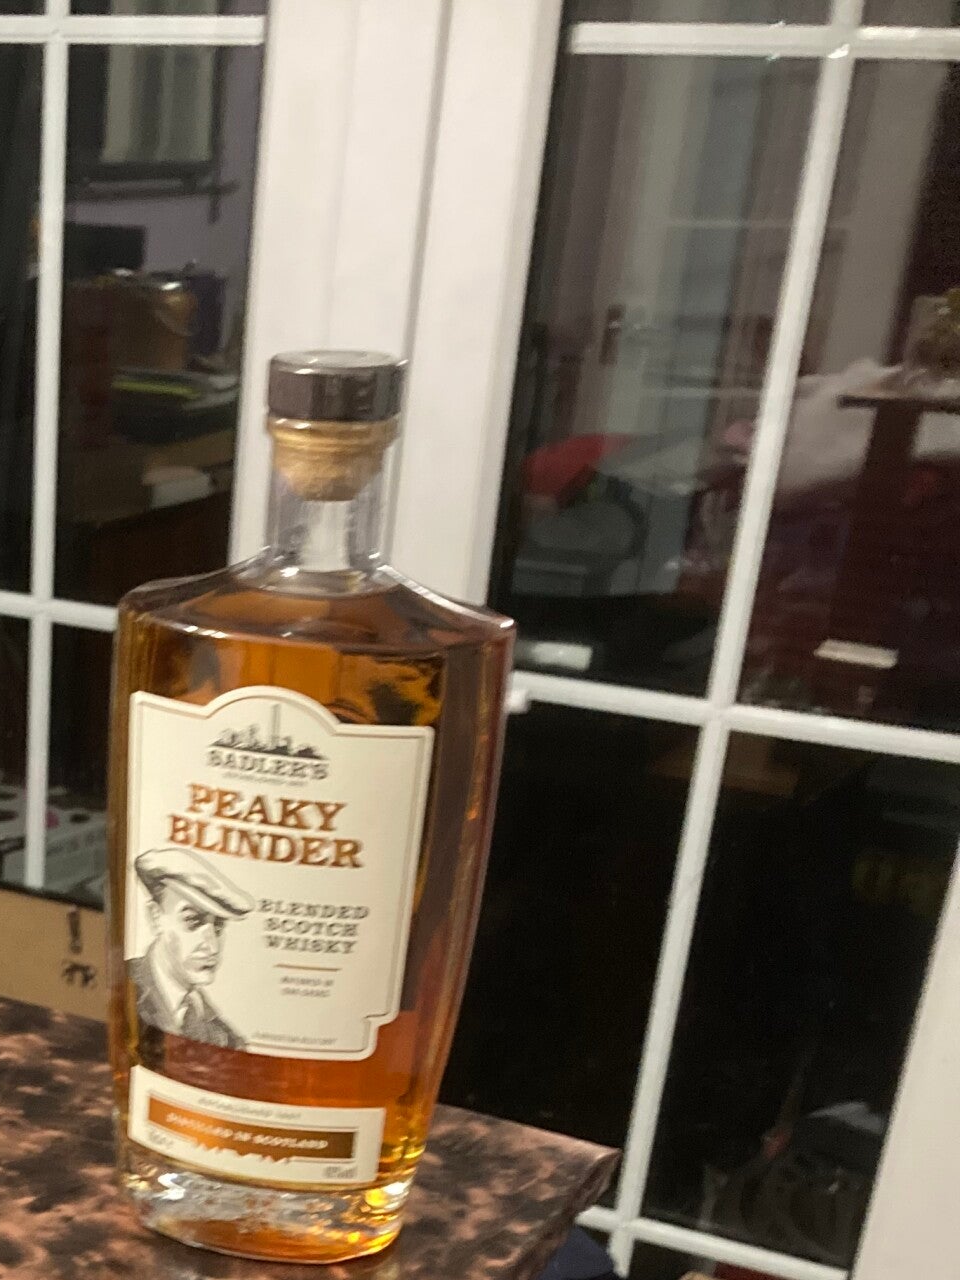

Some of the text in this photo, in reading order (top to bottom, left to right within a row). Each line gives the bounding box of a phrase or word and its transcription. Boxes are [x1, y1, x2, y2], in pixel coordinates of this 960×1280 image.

[207, 749, 329, 780] SADLER'S
[187, 783, 348, 831] PEAKY
[167, 814, 366, 868] BLINDER
[257, 898, 370, 919] BLENDED
[265, 917, 359, 937] SCOTCH
[263, 935, 358, 954] WHISKY
